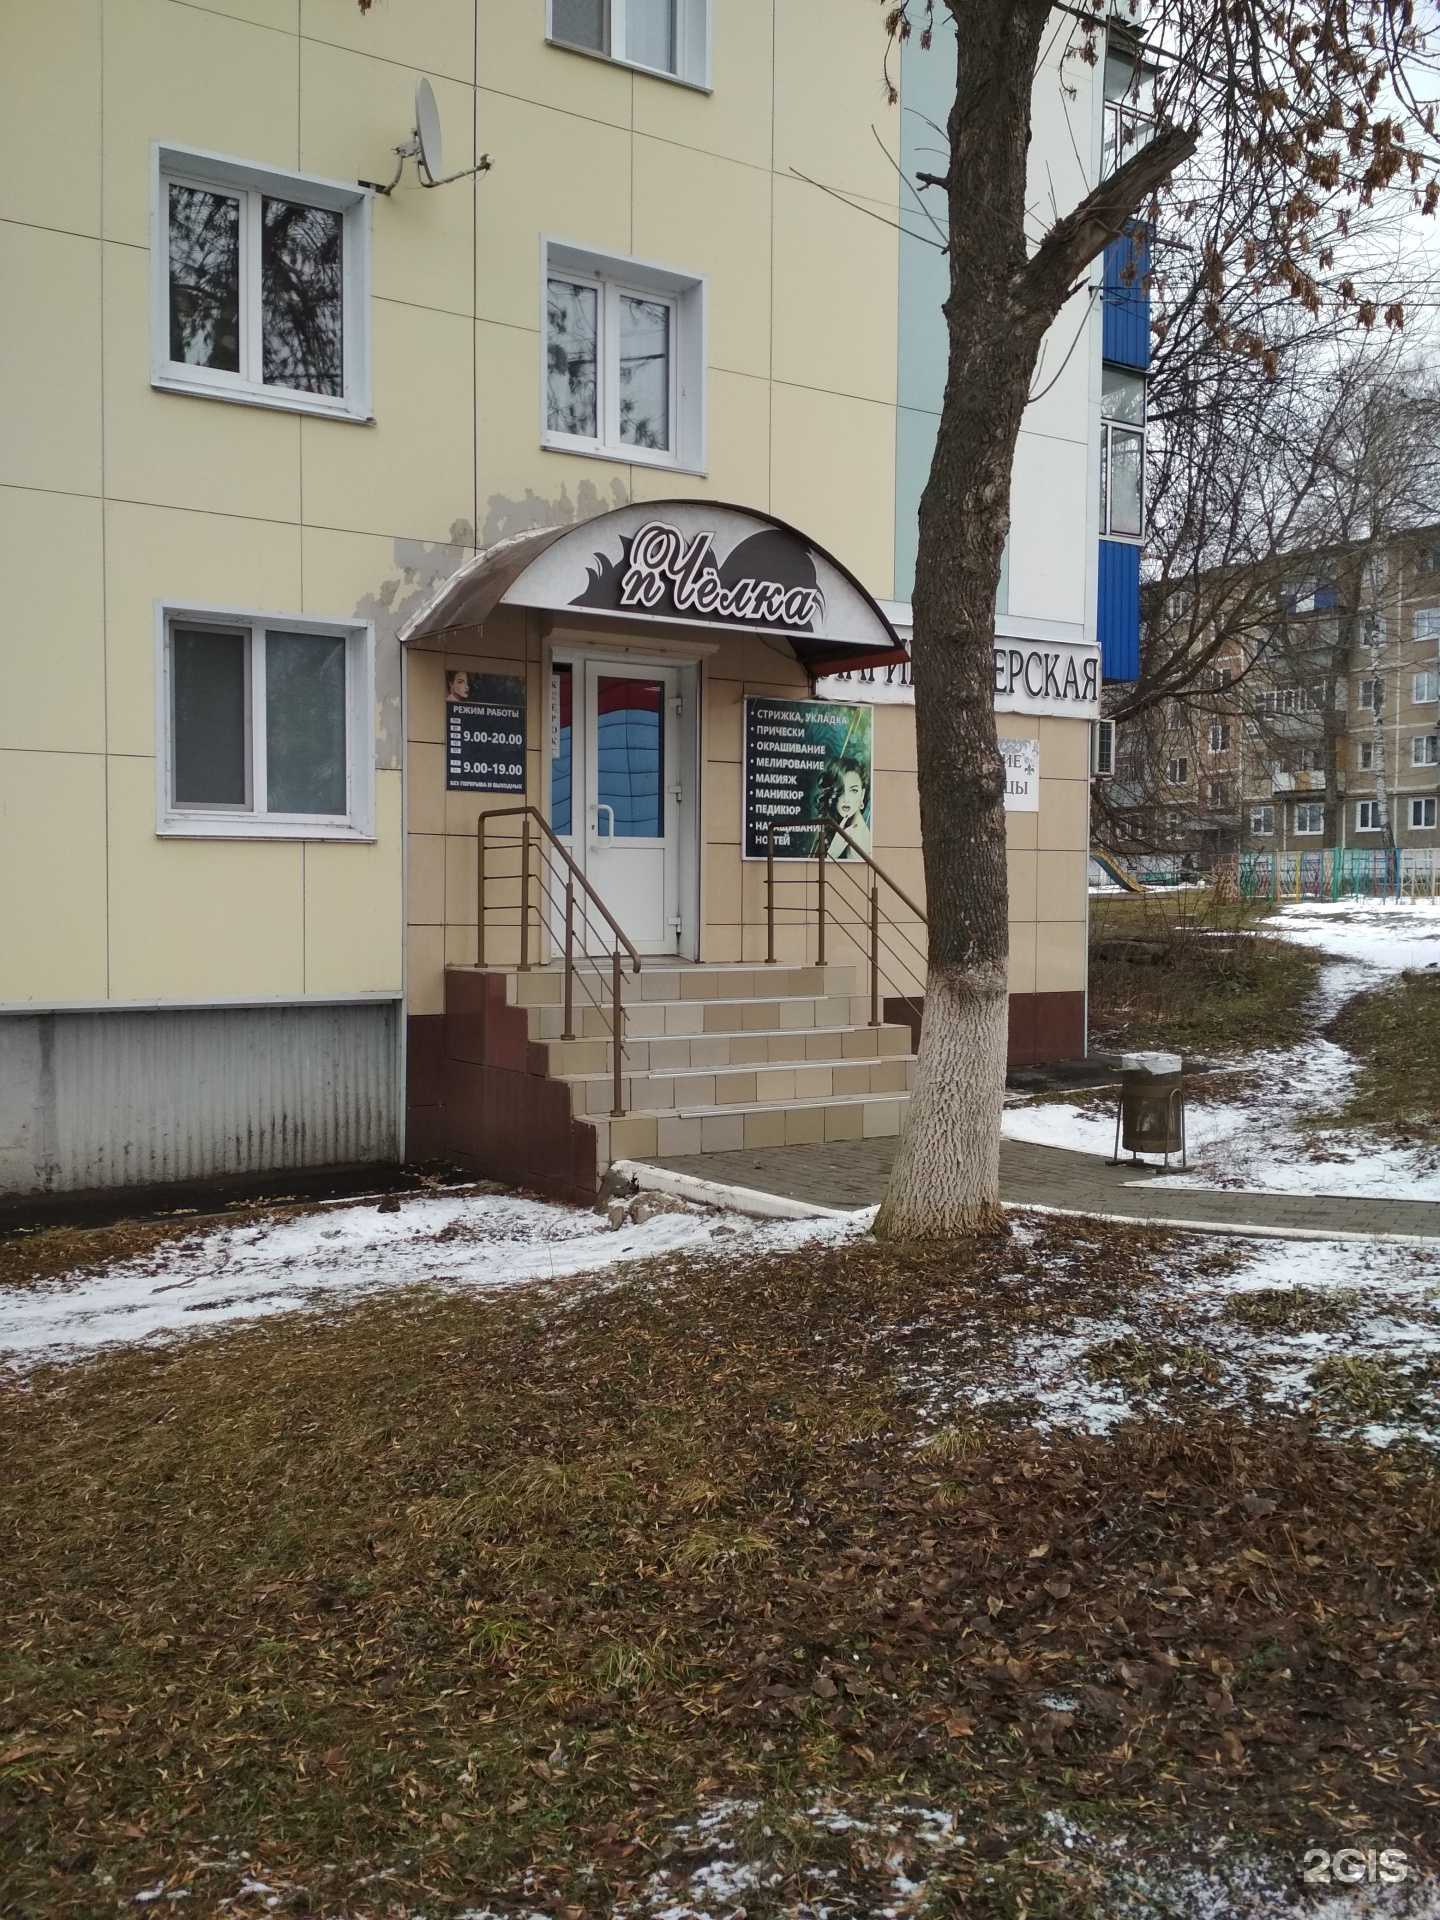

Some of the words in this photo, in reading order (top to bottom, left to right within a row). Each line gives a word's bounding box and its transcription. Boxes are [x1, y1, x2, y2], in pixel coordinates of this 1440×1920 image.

[453, 705, 485, 716] РЕЖИМ
[486, 708, 519, 718] РАБОТЫ
[757, 709, 803, 723] СТРИЖКА,
[805, 712, 848, 725] УКЛАДКА
[463, 731, 522, 745] 9.00-20.00
[756, 725, 805, 738] ПРИЧЕСКИ
[756, 741, 826, 755] ОКРАШИВАНИЕ
[463, 762, 522, 776] 9.00-19.00
[756, 757, 824, 770] МЕЛИРОВАНИЕ
[755, 773, 797, 785] МАКИЯЖ
[755, 788, 804, 800] МАНИКЮР
[755, 804, 801, 816] ПЕДИКЮР
[755, 821, 825, 834] НААЩИВАНИЕ
[755, 833, 791, 846] НОТЕЙ
